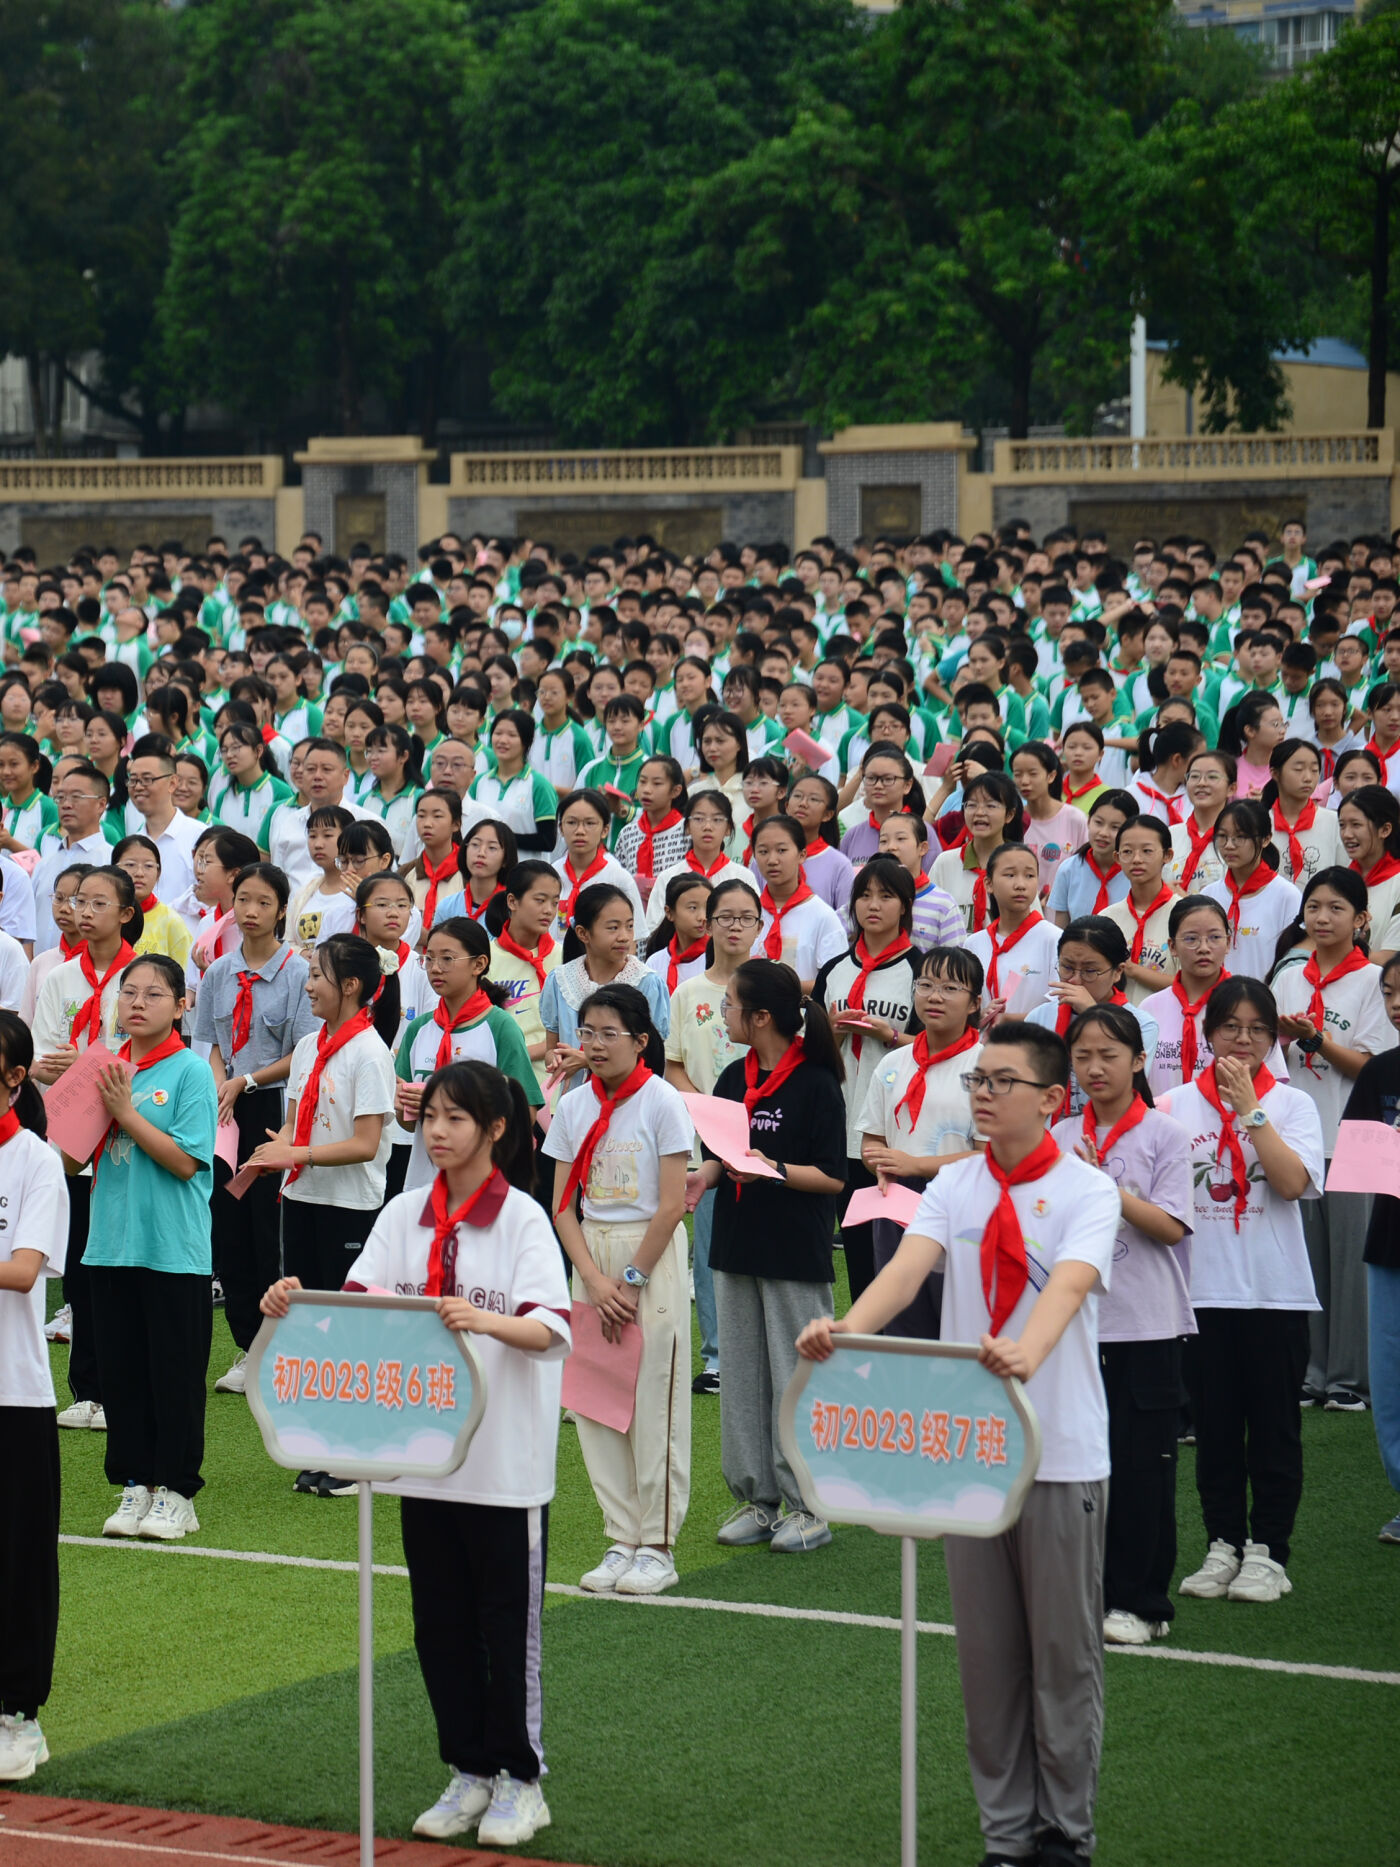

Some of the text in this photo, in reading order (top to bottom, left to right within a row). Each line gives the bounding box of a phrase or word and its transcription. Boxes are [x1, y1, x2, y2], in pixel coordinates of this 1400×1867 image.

[272, 1353, 456, 1413] 初2023级6班
[809, 1397, 1007, 1469] 初2023级7班
